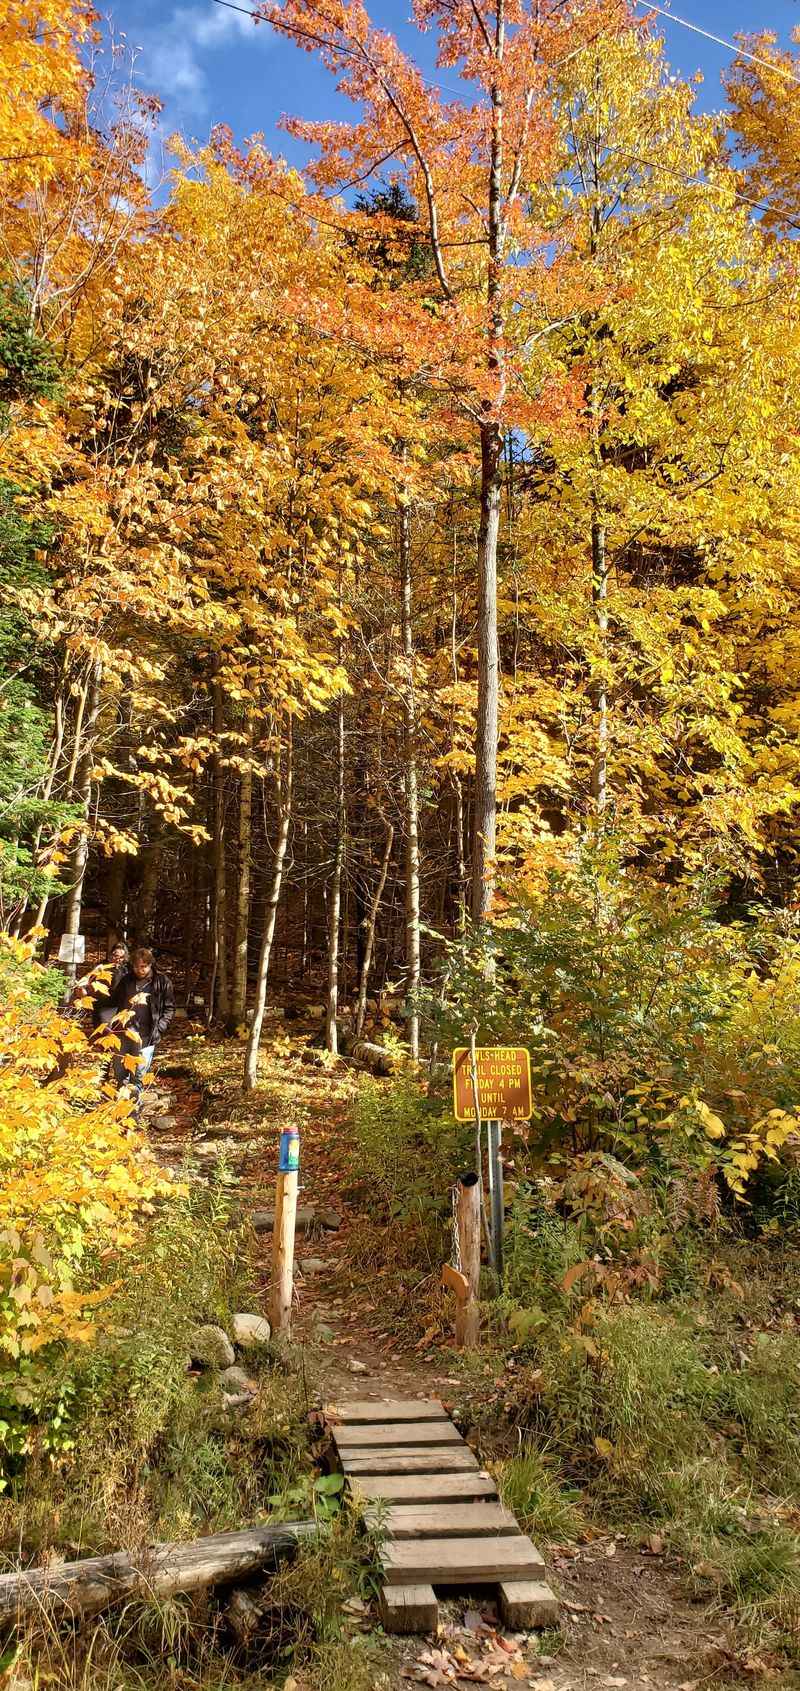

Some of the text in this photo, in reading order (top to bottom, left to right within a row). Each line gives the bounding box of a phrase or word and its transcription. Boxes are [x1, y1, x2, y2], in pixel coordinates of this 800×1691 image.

[462, 1065, 522, 1075] TRIL CLOSED
[499, 1079, 505, 1088] 4
[509, 1079, 521, 1089] PM
[481, 1092, 506, 1103] UNTIL
[502, 1106, 507, 1115] 7
[512, 1106, 524, 1116] AM
